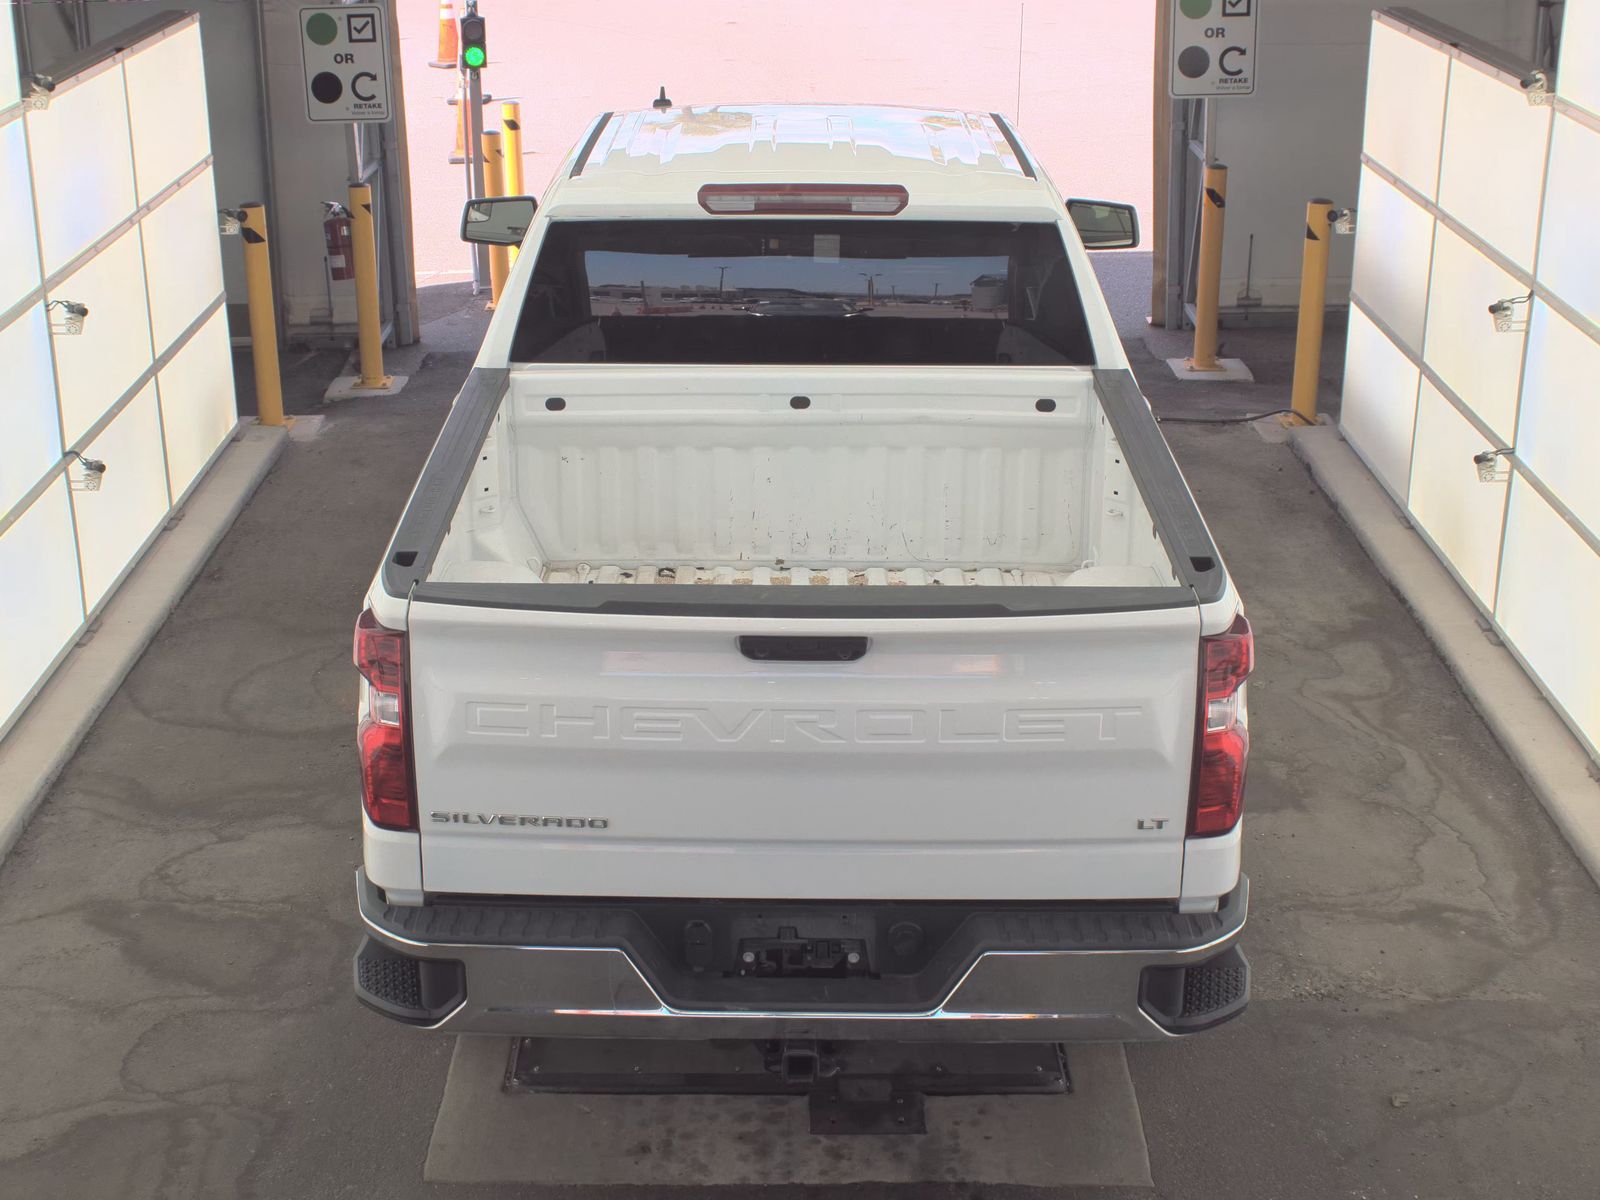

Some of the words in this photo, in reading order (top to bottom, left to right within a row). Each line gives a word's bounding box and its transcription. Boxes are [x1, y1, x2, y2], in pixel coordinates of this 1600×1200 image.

[1204, 27, 1226, 39] OR
[333, 53, 355, 65] OR
[465, 701, 1142, 744] CHEVROLET
[430, 811, 609, 829] SILVERADO
[1136, 817, 1169, 830] LT
